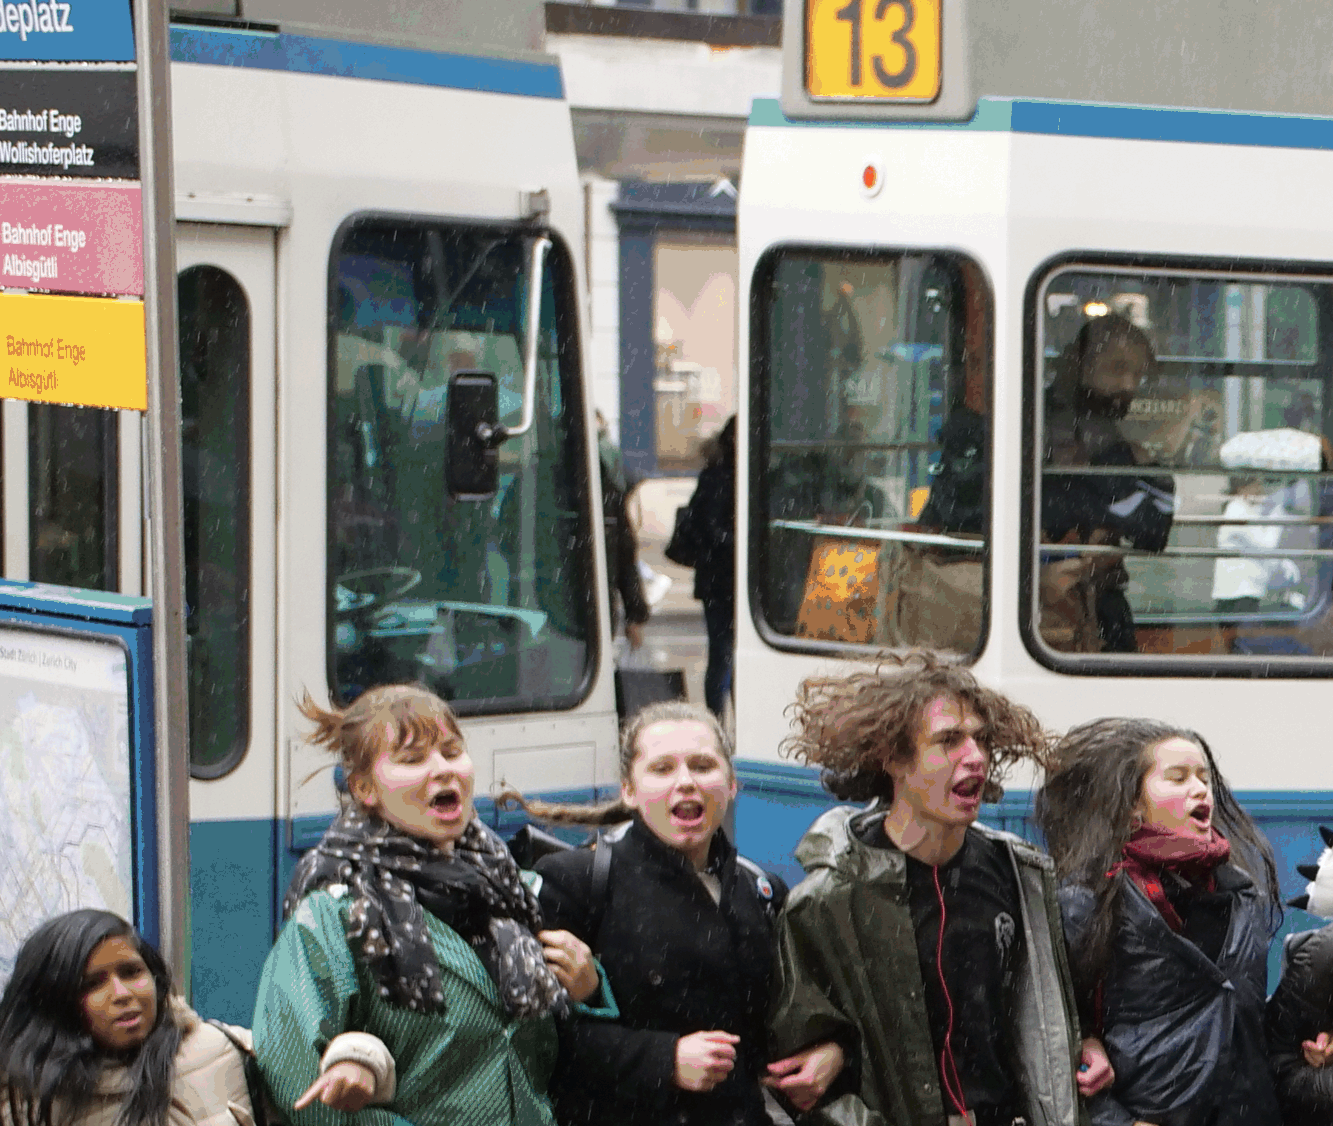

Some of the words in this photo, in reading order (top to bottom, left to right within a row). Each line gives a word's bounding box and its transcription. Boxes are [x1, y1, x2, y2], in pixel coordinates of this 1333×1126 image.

[836, 0, 917, 88] 13
[0, 109, 48, 132] Bahnhof
[50, 109, 82, 138] Enge
[0, 141, 95, 170] Wollishoferplatz
[1, 222, 52, 246] Bahnhof
[54, 224, 86, 252] Enge
[3, 253, 58, 283] Albisgütli
[6, 335, 54, 358] Bahnhof
[57, 338, 86, 366] Enge
